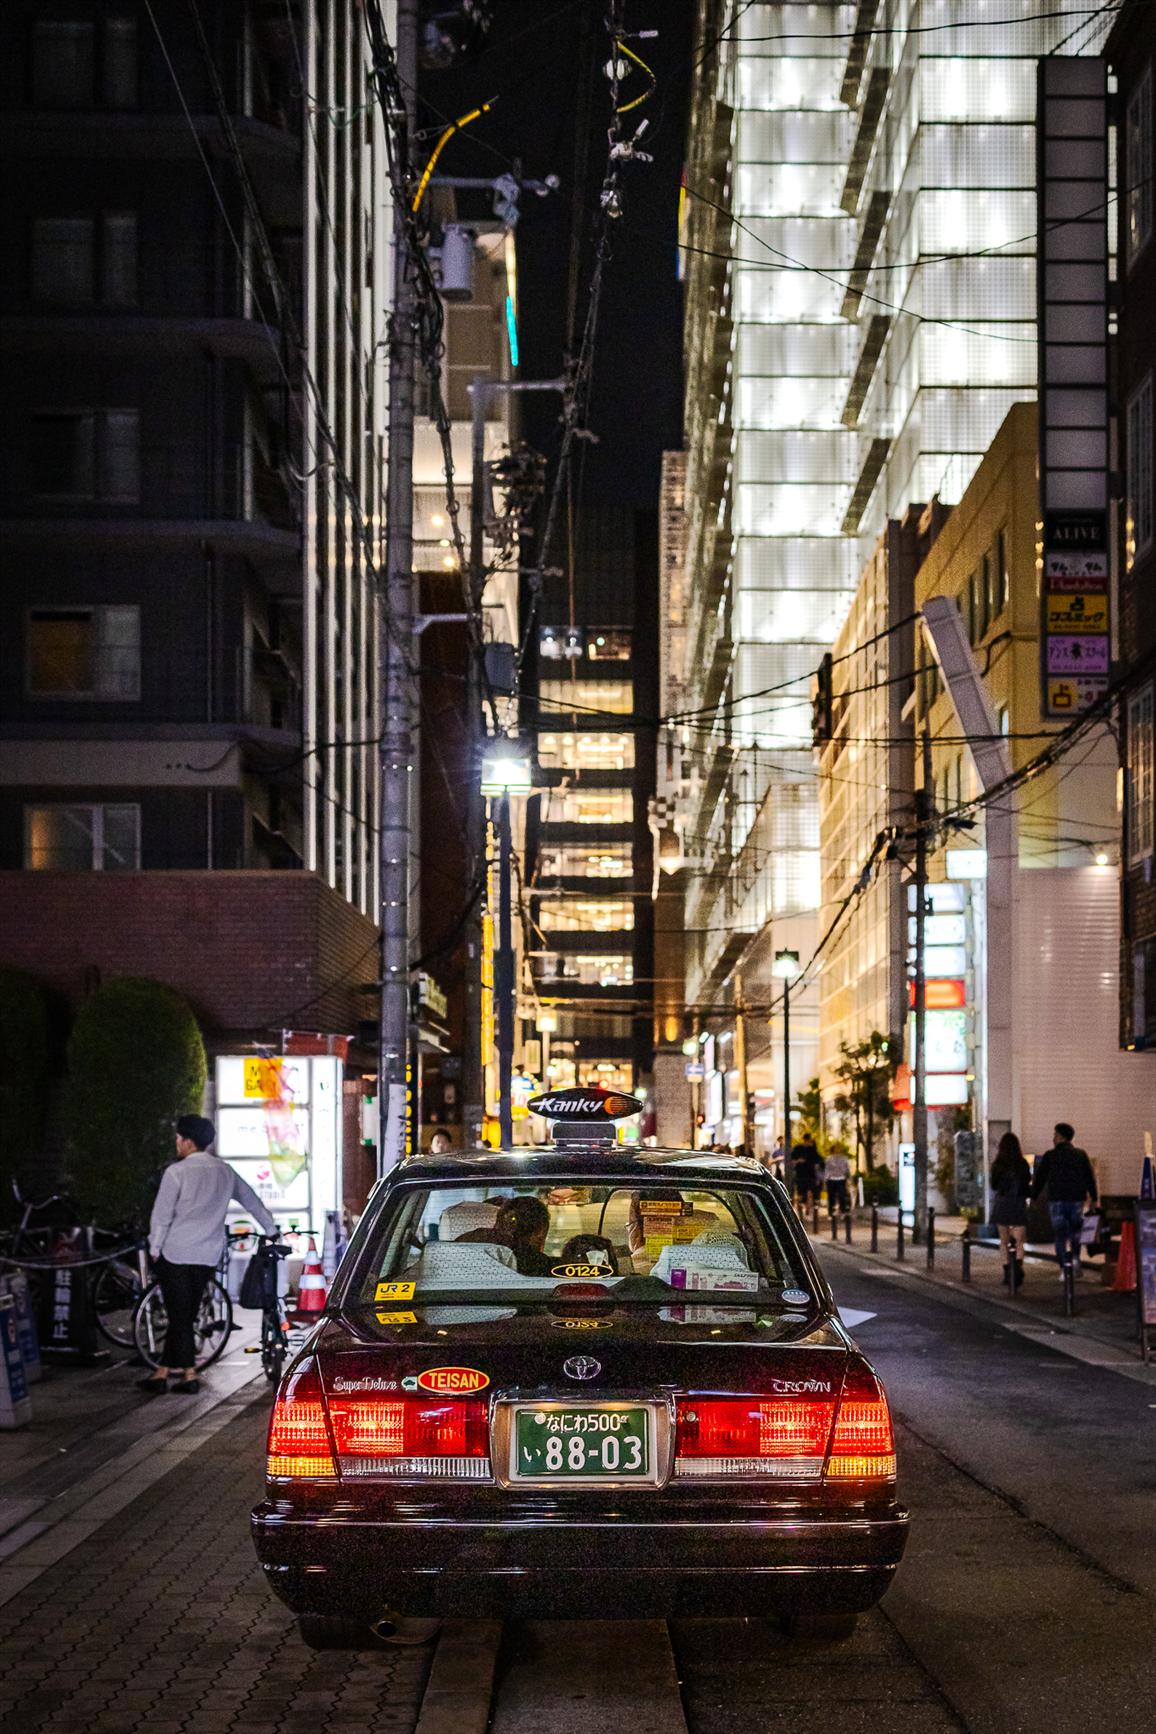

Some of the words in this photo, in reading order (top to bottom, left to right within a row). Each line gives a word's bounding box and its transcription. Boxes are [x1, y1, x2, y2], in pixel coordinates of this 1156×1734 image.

[1054, 527, 1100, 540] ALIVE
[1049, 611, 1105, 622] コスミック
[530, 1097, 604, 1112] Kanky
[565, 1266, 600, 1277] 0124
[380, 1284, 398, 1293] JR
[401, 1284, 410, 1293] 2
[428, 1372, 479, 1388] TEISAN
[771, 1378, 831, 1393] CROWN
[523, 1446, 541, 1463] い
[545, 1436, 642, 1470] 88-03
